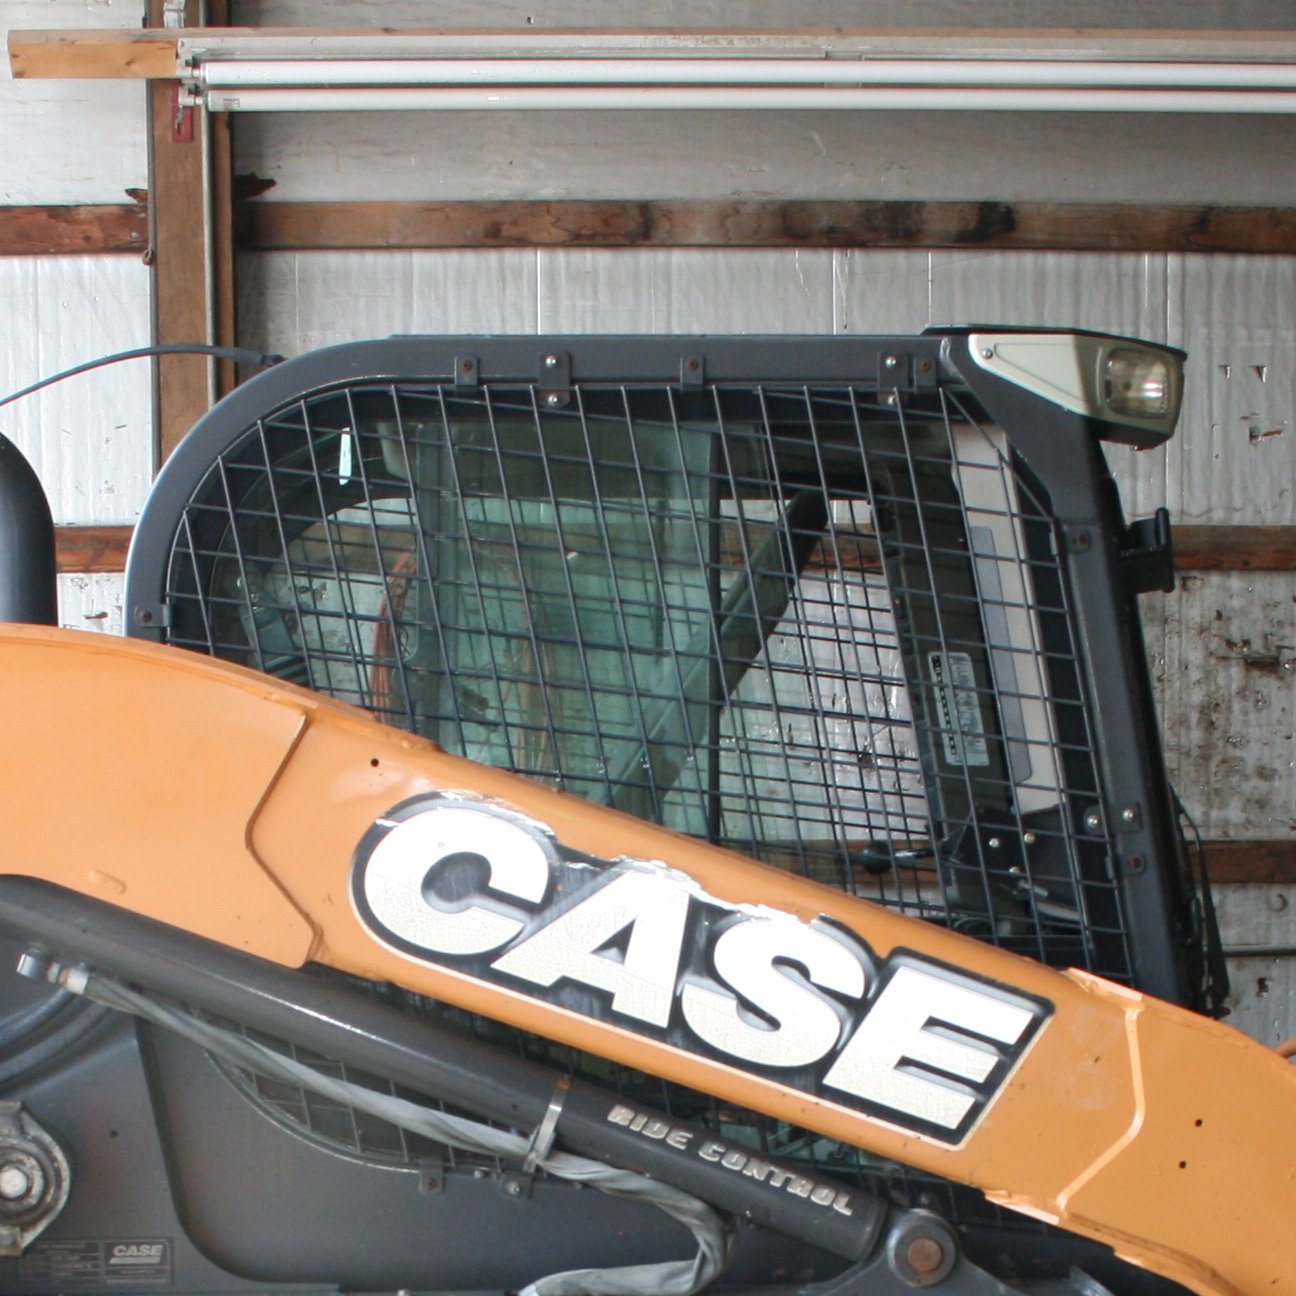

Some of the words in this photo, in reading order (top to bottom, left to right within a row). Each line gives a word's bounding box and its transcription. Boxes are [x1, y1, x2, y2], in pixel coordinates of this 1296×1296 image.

[351, 788, 1056, 1152] CASE
[606, 1103, 694, 1151] RIDE
[698, 1140, 854, 1217] CONTROL
[111, 1243, 165, 1258] CASE
